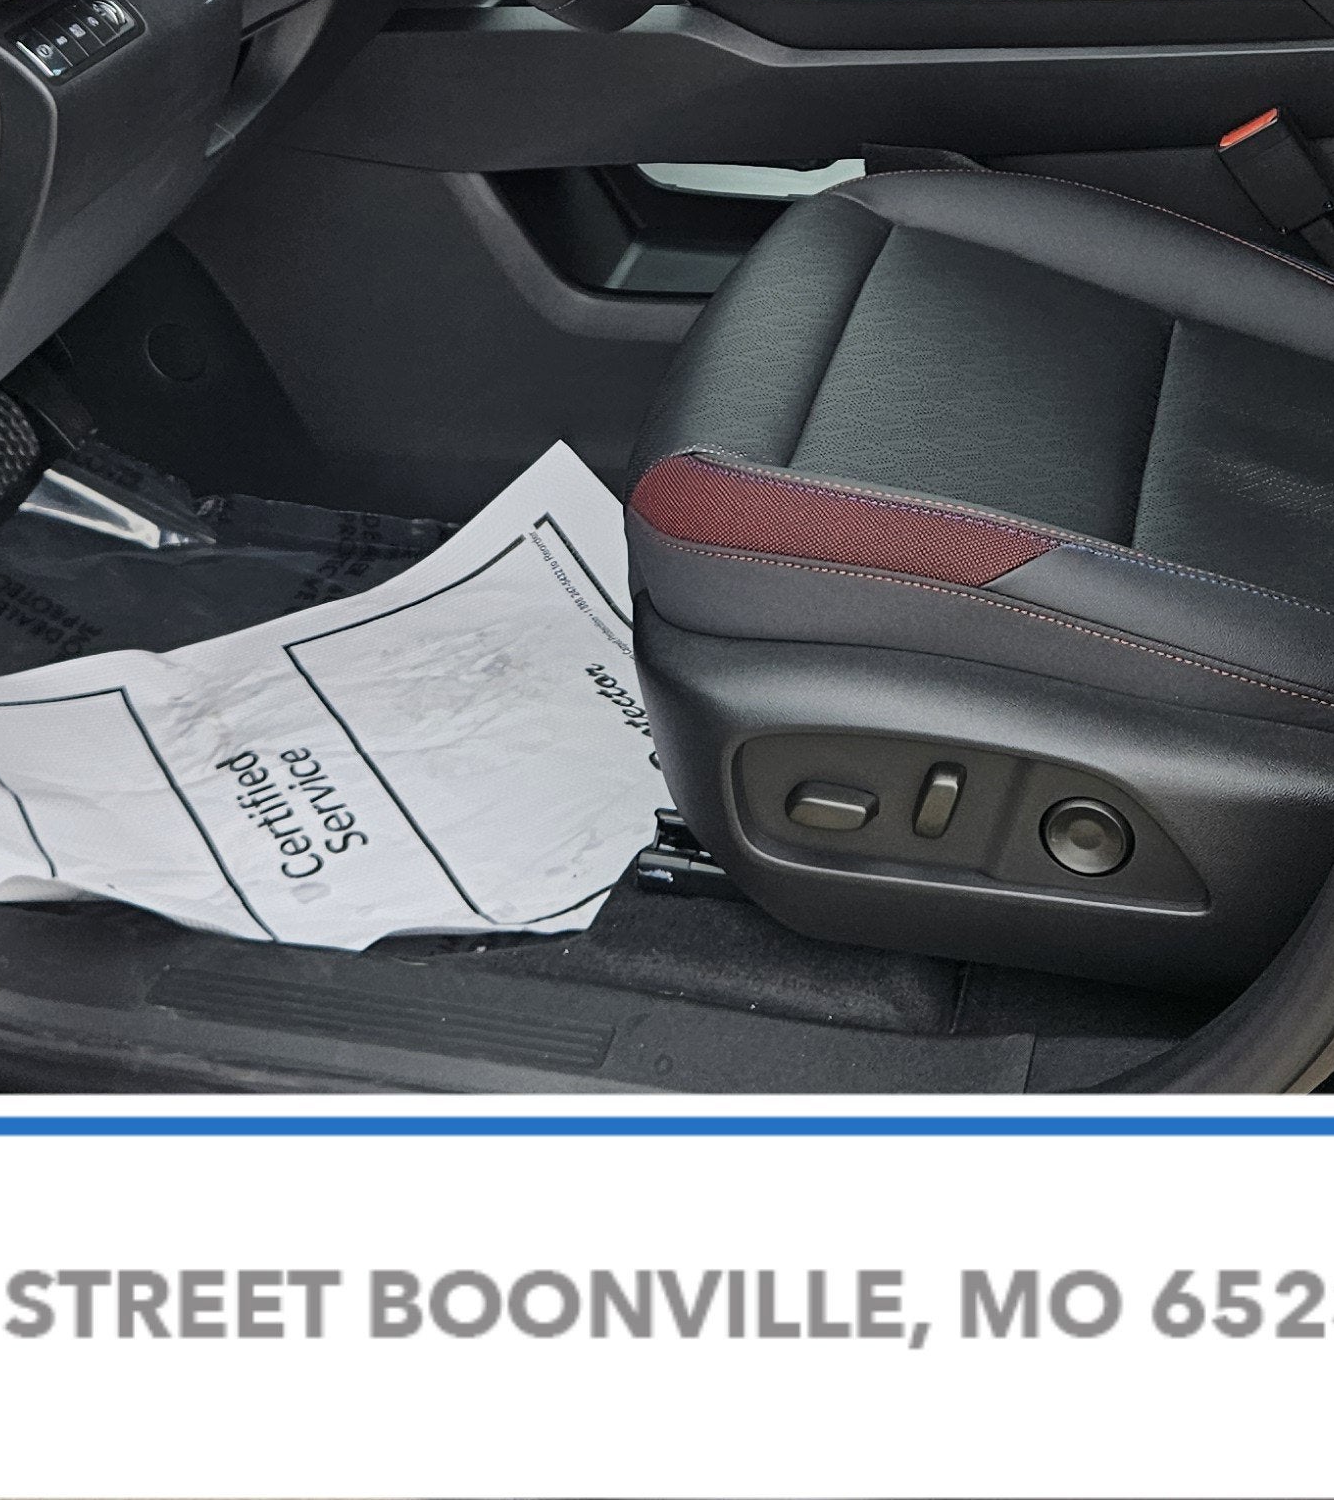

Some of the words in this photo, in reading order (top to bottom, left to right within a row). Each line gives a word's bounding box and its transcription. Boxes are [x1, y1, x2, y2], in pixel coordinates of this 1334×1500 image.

[529, 531, 554, 562] Reorder
[585, 663, 662, 771] tector
[215, 750, 325, 879] Certified
[280, 747, 370, 854] Service
